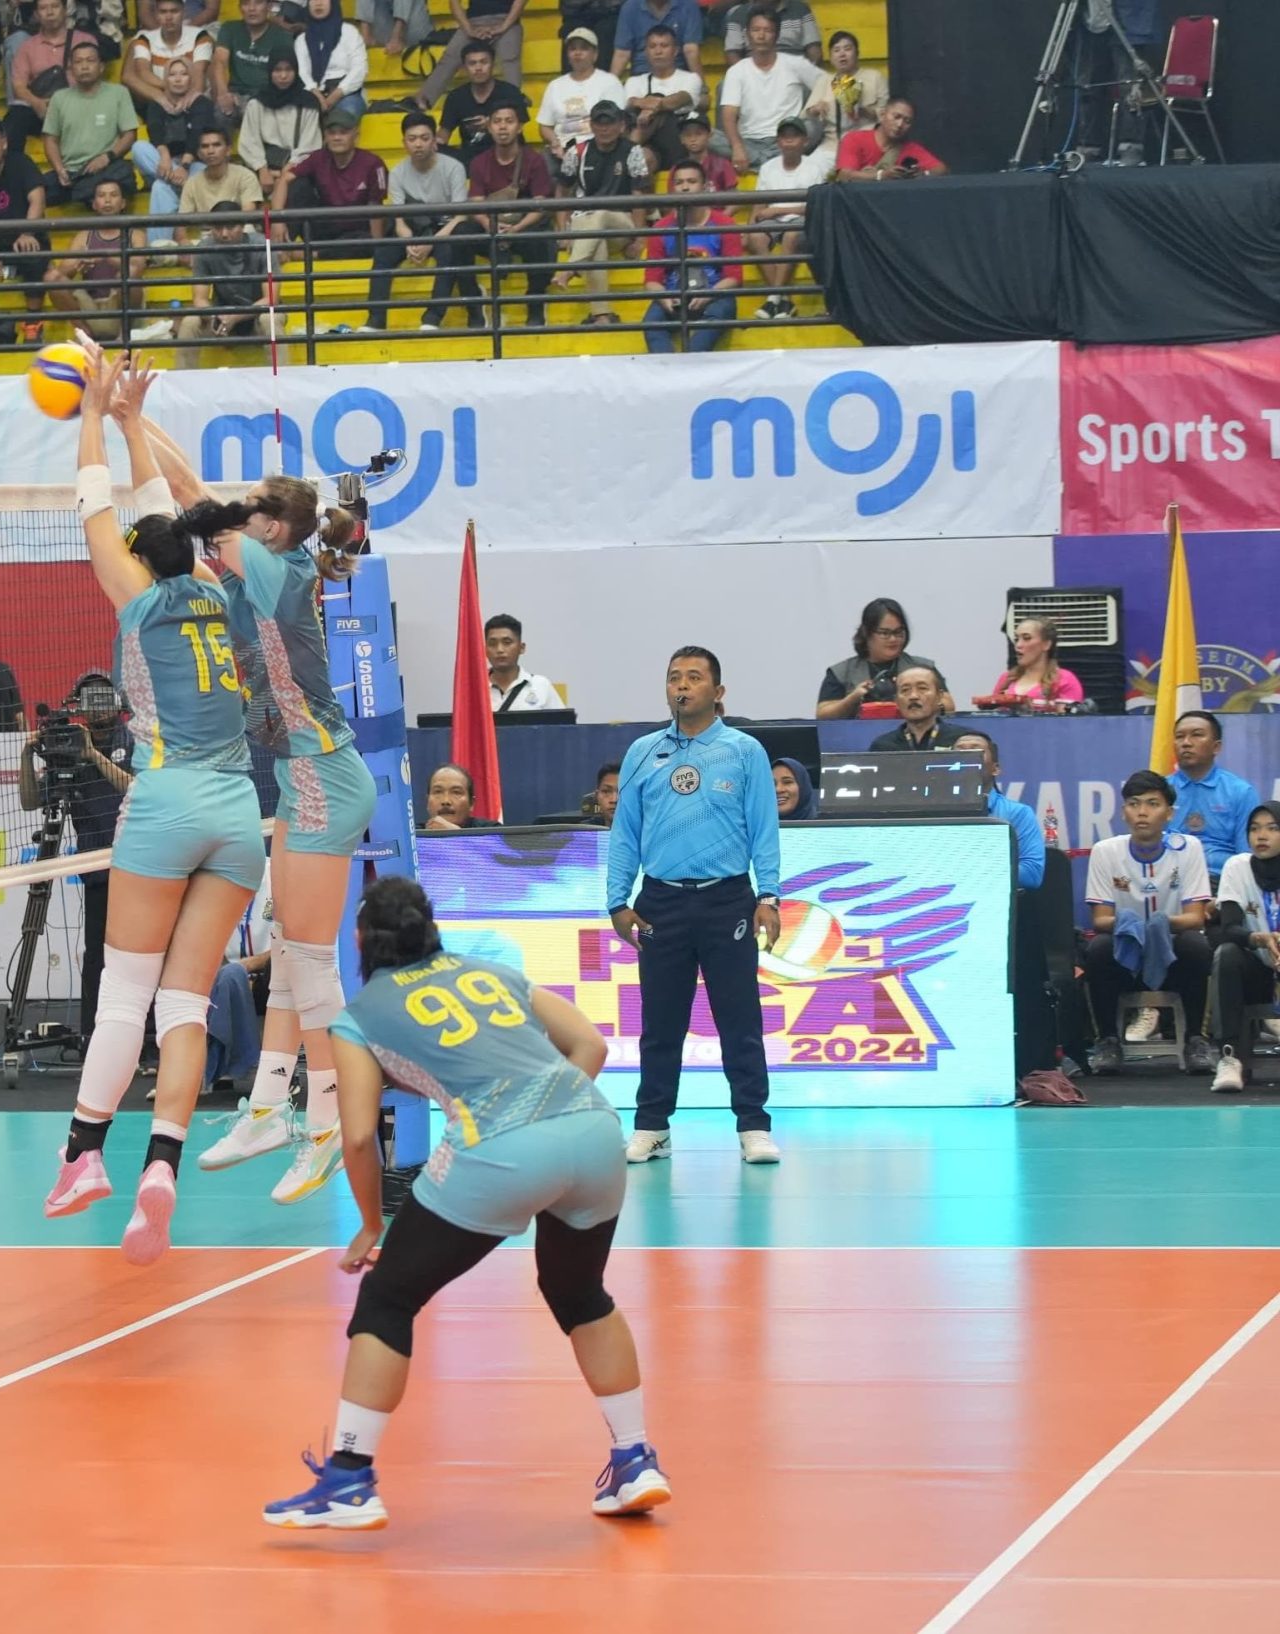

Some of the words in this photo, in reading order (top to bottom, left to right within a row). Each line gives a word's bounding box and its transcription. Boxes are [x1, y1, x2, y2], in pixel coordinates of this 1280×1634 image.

[1078, 413, 1247, 472] Sports
[336, 619, 361, 630] FIVB
[181, 621, 240, 694] 15
[358, 659, 376, 718] Senoh
[405, 970, 527, 1048] 99
[790, 1037, 925, 1063] 2024
